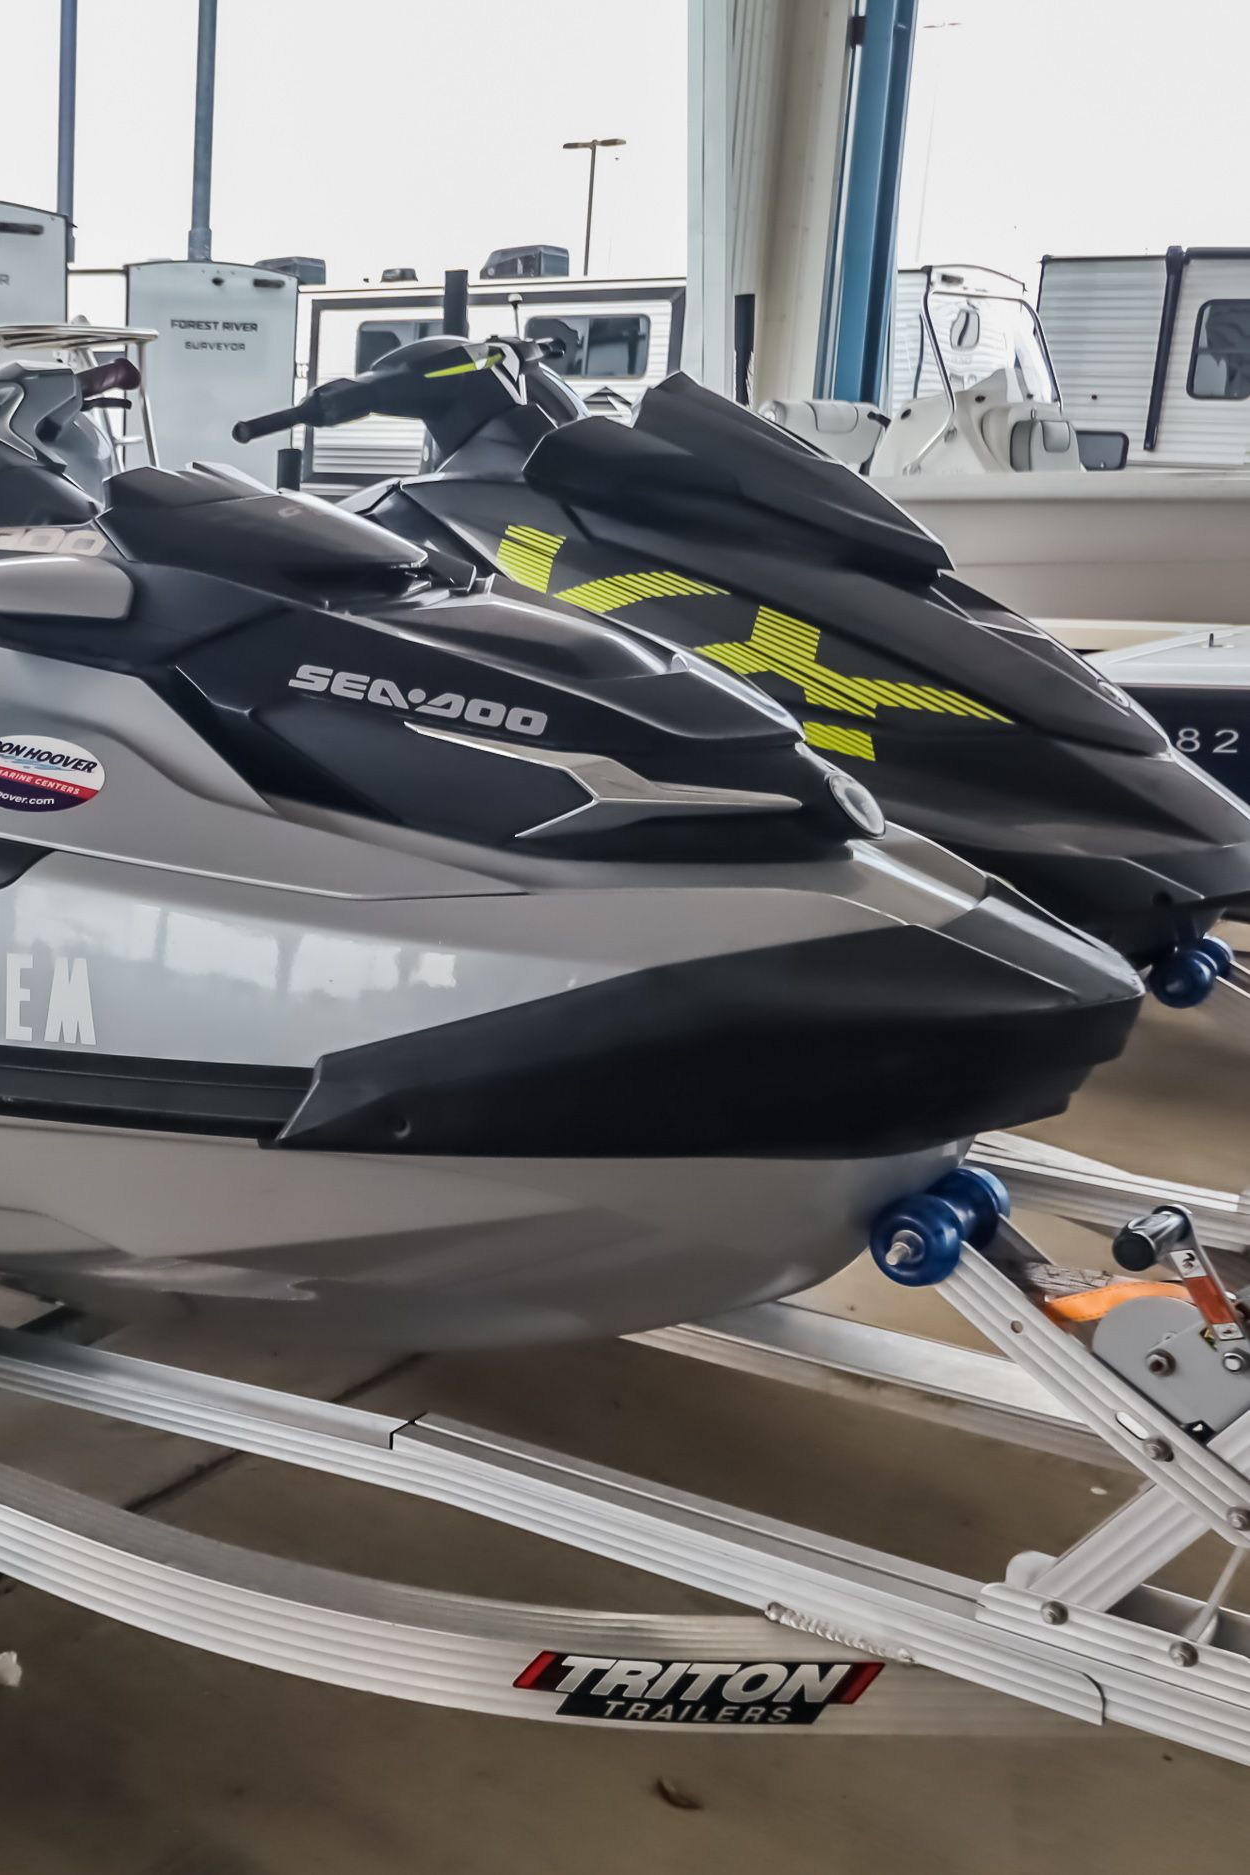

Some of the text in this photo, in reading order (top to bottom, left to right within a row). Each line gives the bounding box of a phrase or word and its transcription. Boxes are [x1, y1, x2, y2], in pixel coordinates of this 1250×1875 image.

[171, 319, 258, 332] FOREST RIVER
[184, 341, 246, 351] SURVEYOR
[26, 748, 98, 774] HOOVER
[34, 778, 80, 796] CENTERS
[555, 1655, 852, 1703] TRITON
[604, 1701, 792, 1723] TRAILERS
